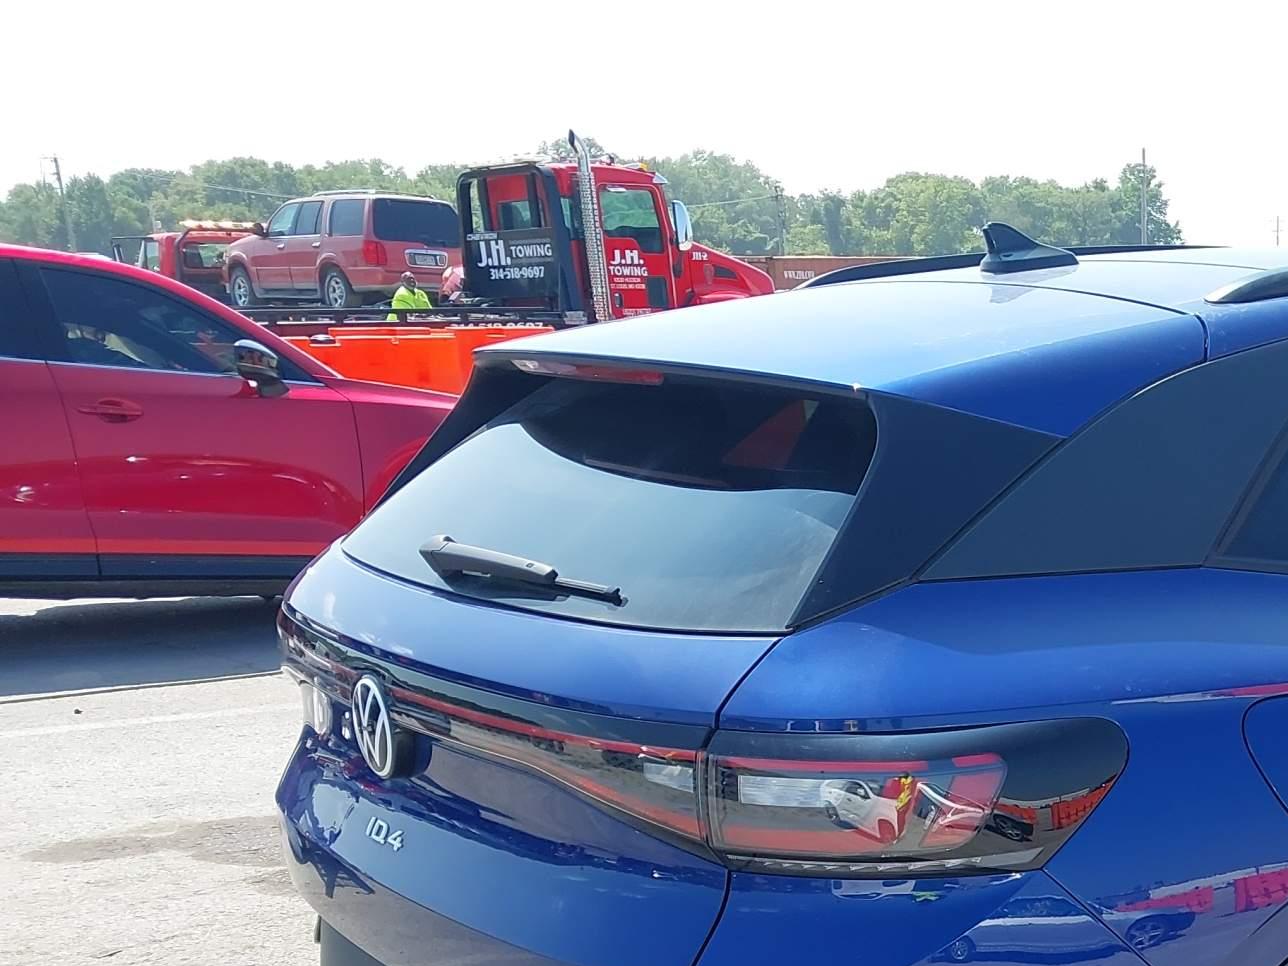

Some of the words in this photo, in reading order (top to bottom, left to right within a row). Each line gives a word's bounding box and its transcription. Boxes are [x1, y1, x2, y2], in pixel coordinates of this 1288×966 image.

[477, 239, 512, 267] J.H.
[510, 243, 552, 258] TOWING
[609, 249, 645, 265] J.H.
[608, 266, 649, 276] TOWING
